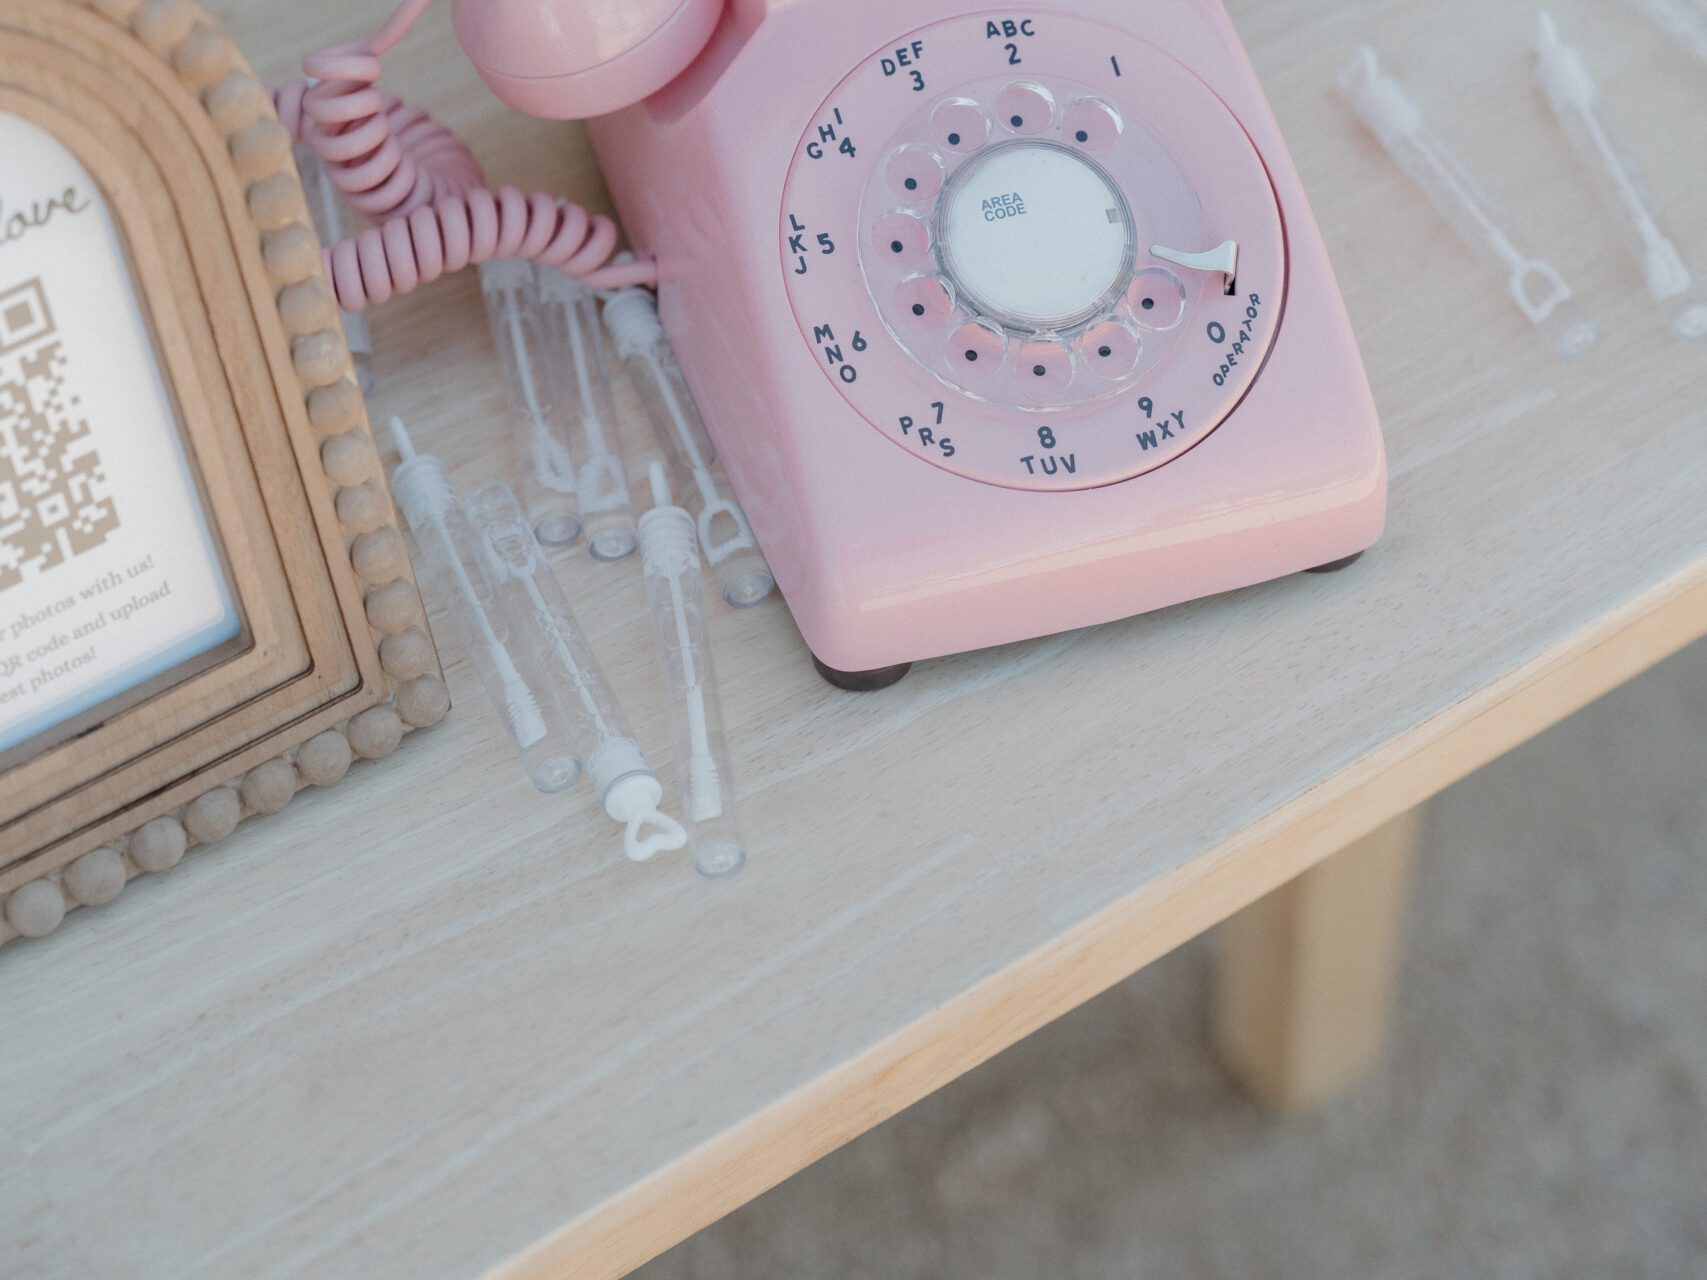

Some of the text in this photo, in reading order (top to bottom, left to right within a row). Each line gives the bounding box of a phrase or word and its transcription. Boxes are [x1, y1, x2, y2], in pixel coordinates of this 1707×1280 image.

[985, 20, 1036, 40] ABC
[880, 41, 925, 76] DEF
[1004, 44, 1022, 64] 2
[910, 70, 925, 91] 3
[839, 137, 856, 158] 4
[981, 192, 1023, 212] AREA
[984, 203, 1028, 222] CODE
[0, 186, 92, 243] ove
[816, 233, 835, 255] 5
[852, 331, 867, 352] 6
[1212, 293, 1262, 387] OPERATOR
[814, 324, 857, 383] MNO
[931, 402, 946, 425] 7
[1138, 396, 1154, 418] 9
[900, 416, 956, 457] PRS
[1038, 427, 1056, 449] 8
[1136, 410, 1186, 451] WXY
[1020, 454, 1076, 475] TUV
[11, 595, 76, 638] photos
[79, 572, 123, 600] with
[126, 554, 154, 578] us!
[27, 635, 69, 662] code
[73, 613, 107, 640] and
[109, 580, 171, 620] upload
[30, 645, 97, 693] photos!
